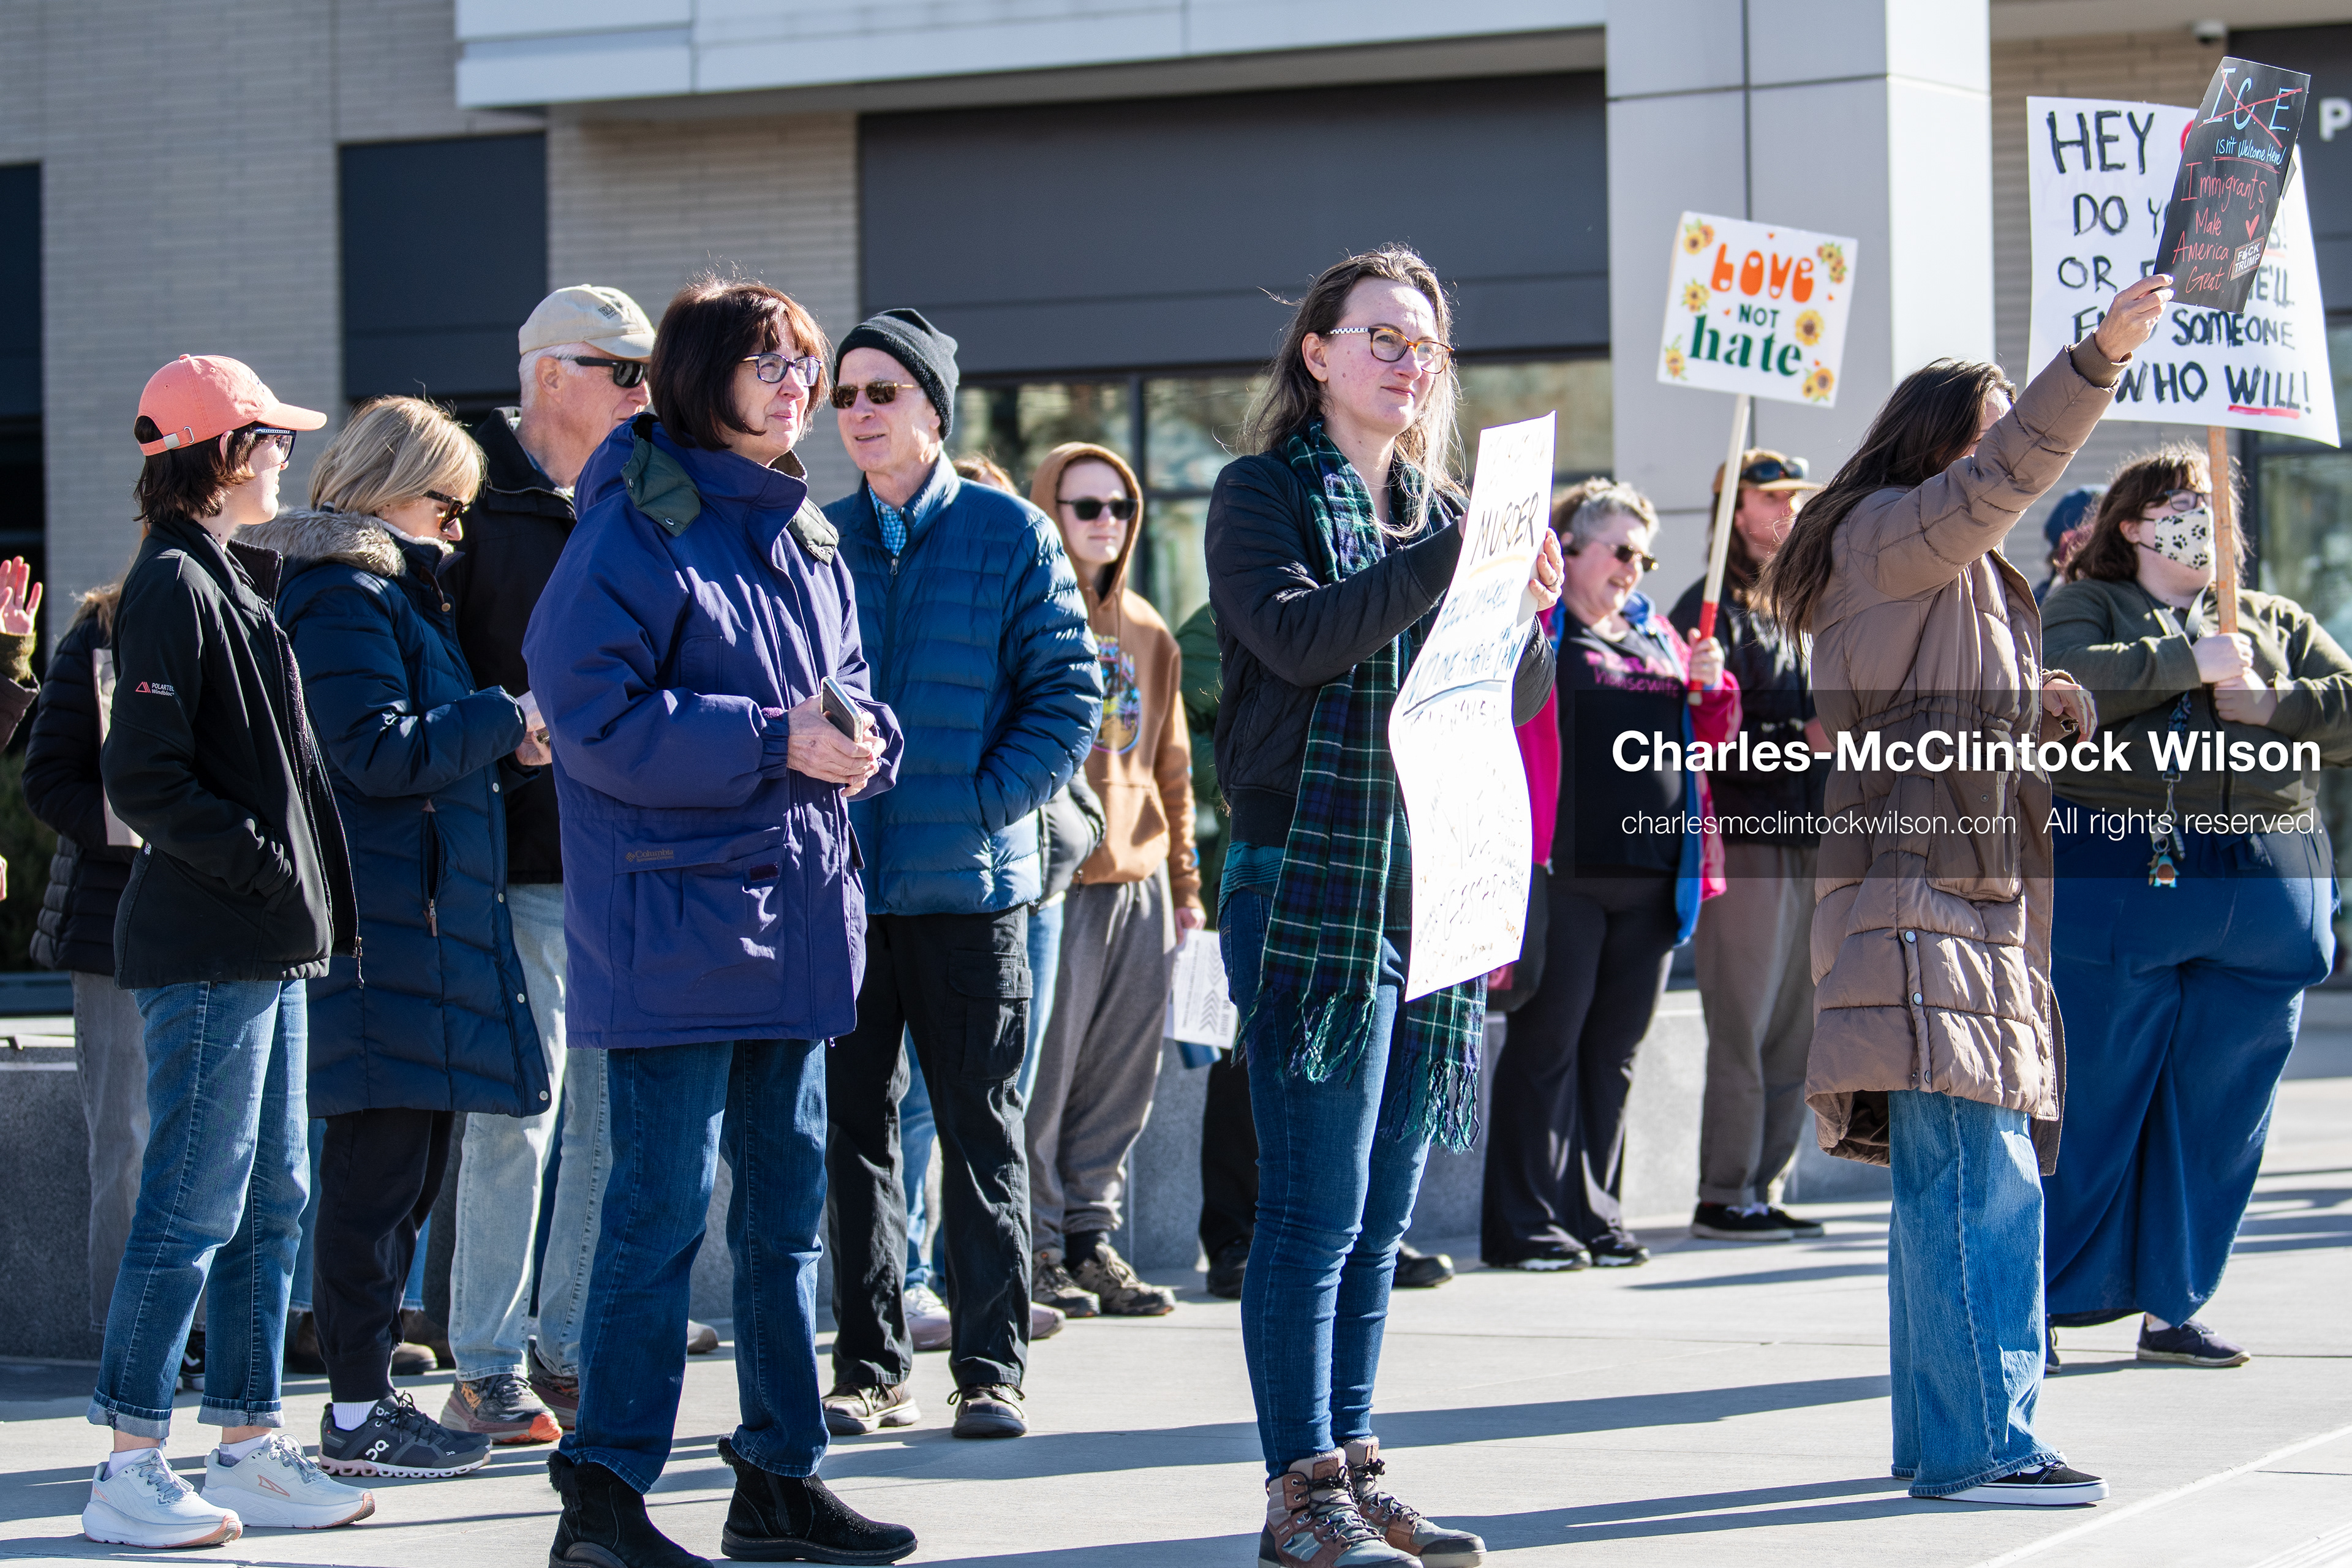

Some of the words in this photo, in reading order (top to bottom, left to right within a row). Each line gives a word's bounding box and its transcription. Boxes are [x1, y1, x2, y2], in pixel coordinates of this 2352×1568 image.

[2046, 110, 2155, 175] HEY
[2237, 139, 2266, 162] Welcome
[2266, 143, 2287, 169] Here!
[2181, 162, 2267, 213] Immigrants
[2073, 194, 2128, 235] DO
[2196, 207, 2222, 236] Make
[2057, 255, 2117, 293] OR
[2185, 261, 2234, 293] Great!
[2235, 253, 2260, 273] TRUMP
[1739, 303, 1780, 328] NOT
[2171, 307, 2296, 349] SOMEONE
[1689, 314, 1803, 377] hate
[2114, 360, 2208, 404] WHO
[2225, 363, 2310, 414] WILL!
[1471, 491, 1539, 565] MURDER
[1493, 633, 1525, 679] LAW
[152, 682, 175, 692] POLARTEC
[1593, 665, 1679, 698] housewife
[635, 849, 674, 858] Columbia
[1444, 874, 1507, 941] GESTAPO
